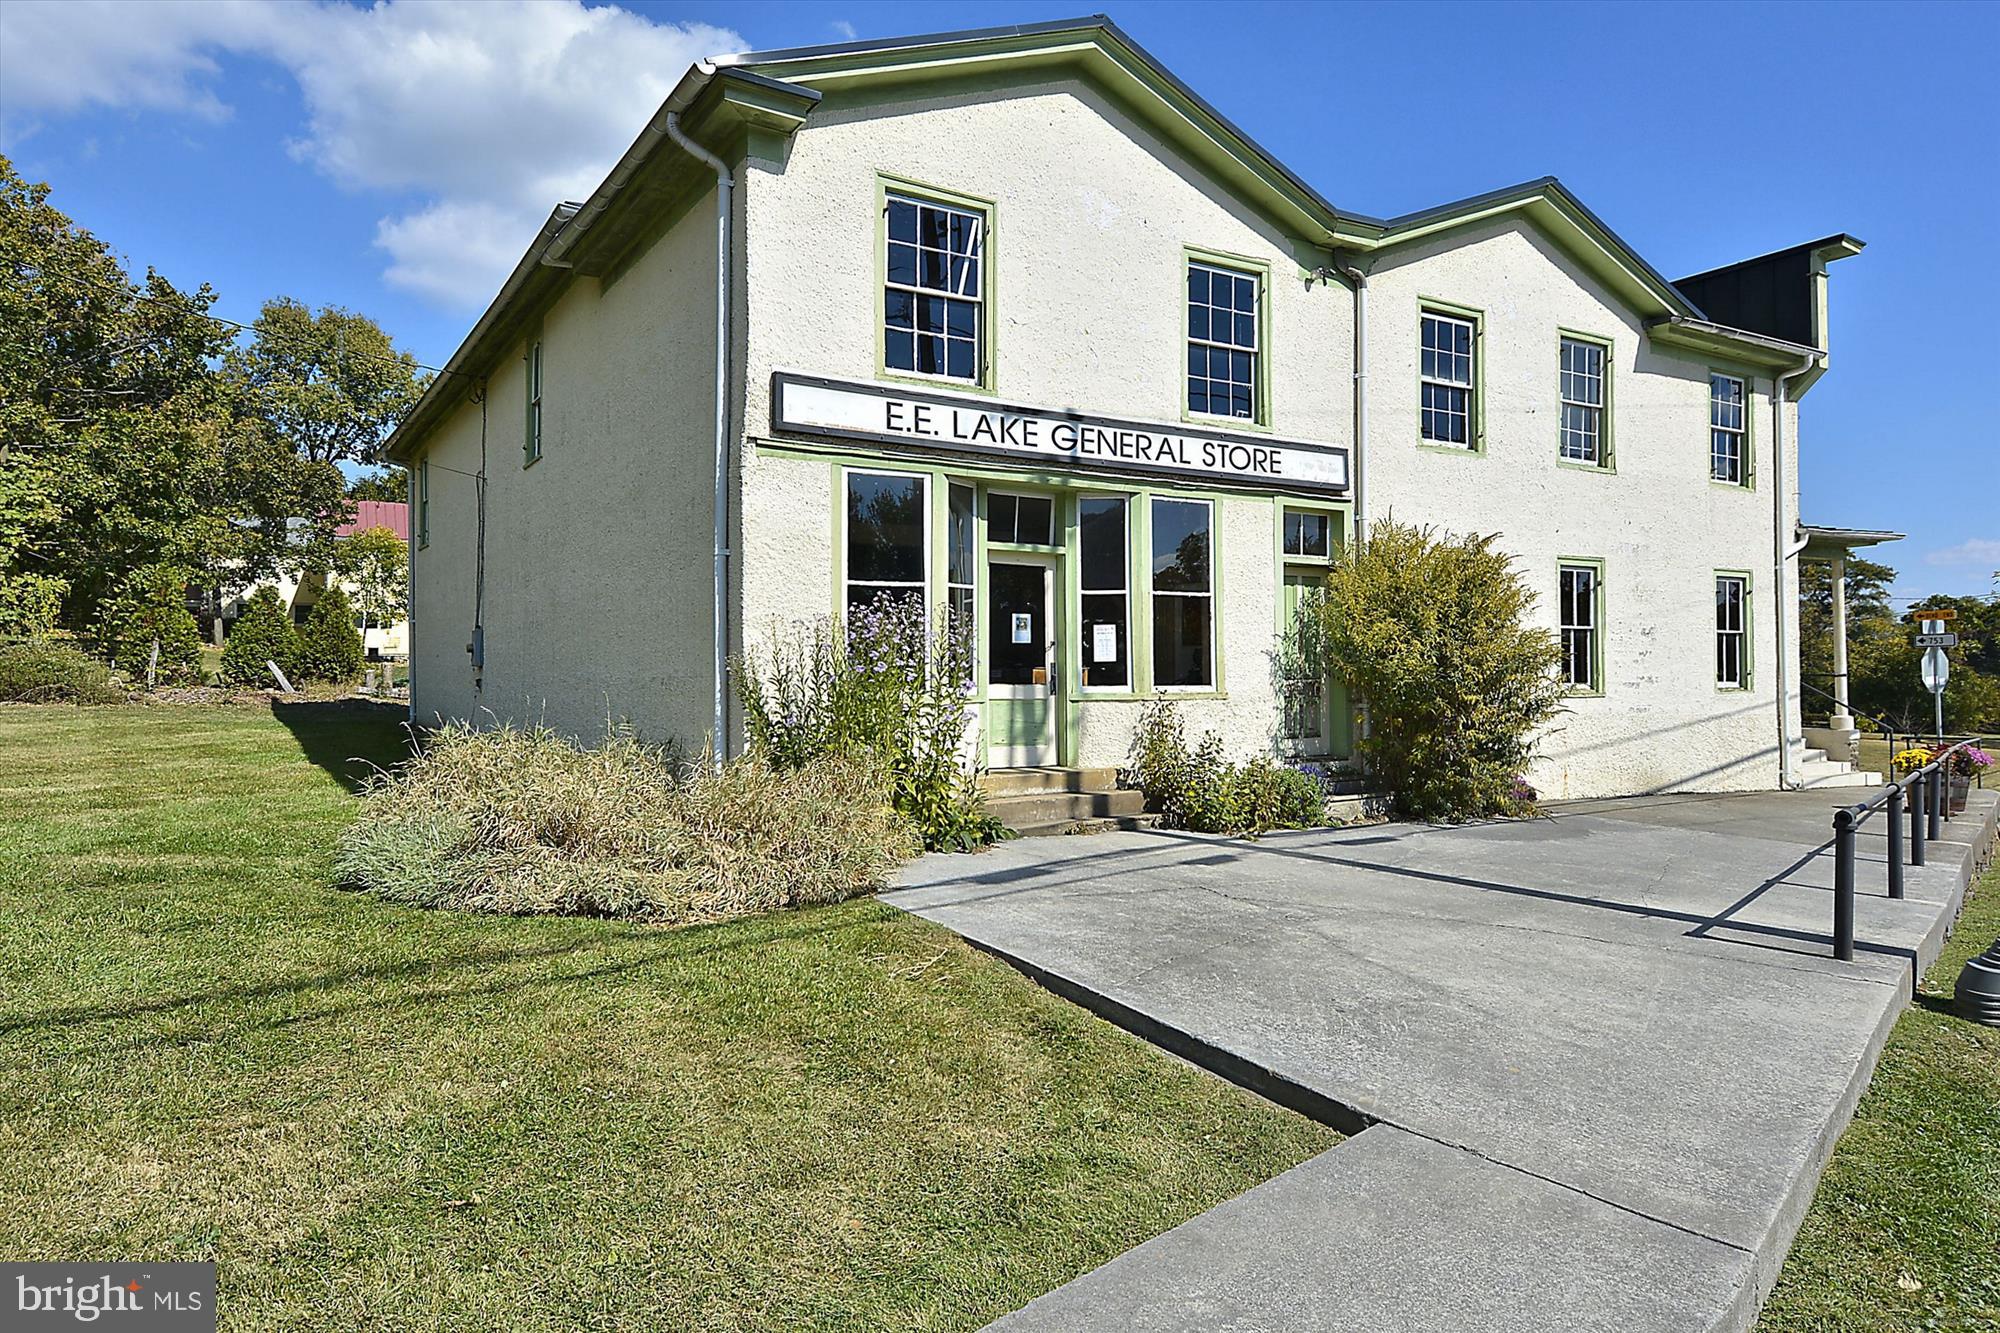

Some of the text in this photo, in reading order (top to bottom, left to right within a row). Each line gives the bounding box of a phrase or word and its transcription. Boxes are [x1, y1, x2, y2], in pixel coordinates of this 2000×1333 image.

[886, 401, 1282, 474] E.E. LAKE GENERAL STORE
[1929, 637, 1944, 645] 753
